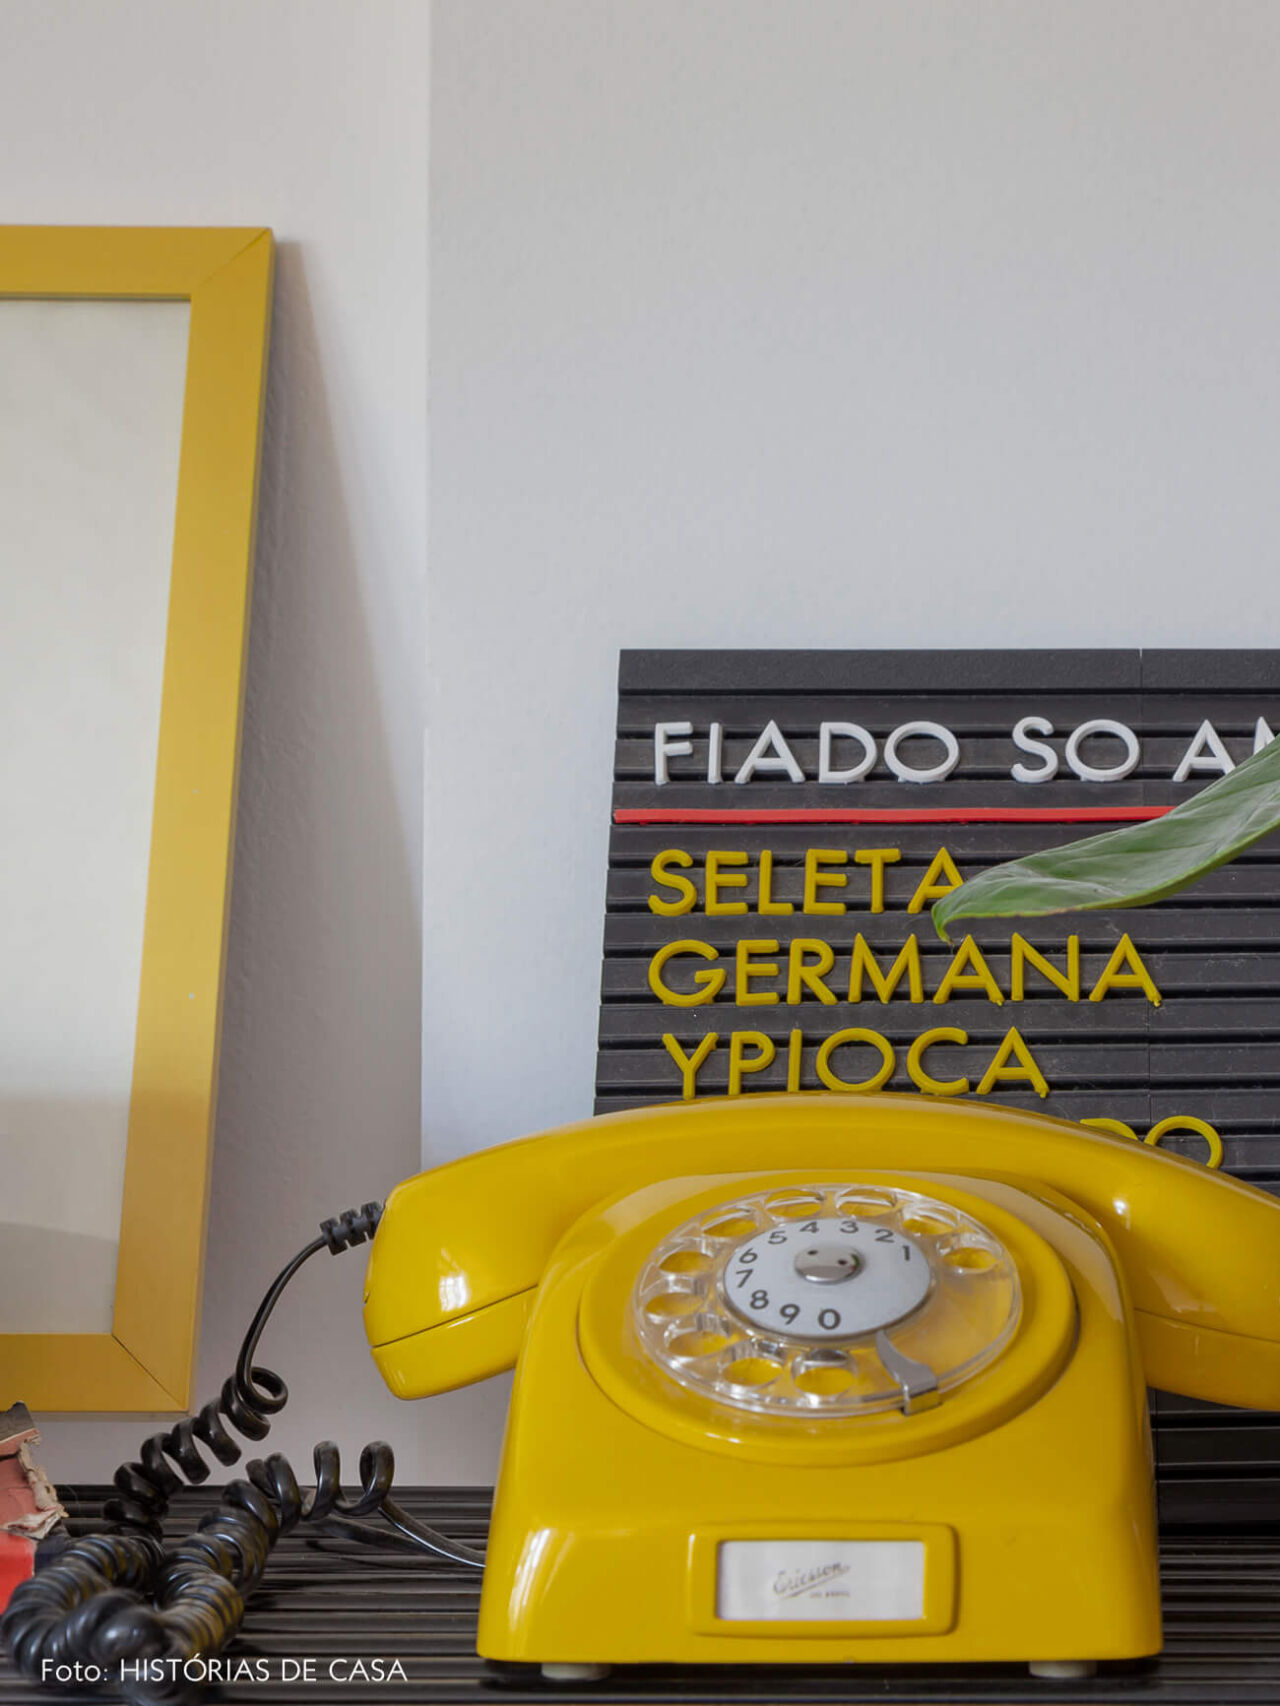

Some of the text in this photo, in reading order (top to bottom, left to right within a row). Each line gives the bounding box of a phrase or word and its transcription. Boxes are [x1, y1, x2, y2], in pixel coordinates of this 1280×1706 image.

[653, 719, 960, 785] FIADO
[1010, 716, 1141, 784] SO
[647, 846, 965, 917] SELETA
[647, 932, 1163, 1008] GERMANA
[661, 1026, 1051, 1099] YPIOCA
[735, 1220, 911, 1331] 1 2 3 4 5 6 7 8 9 0
